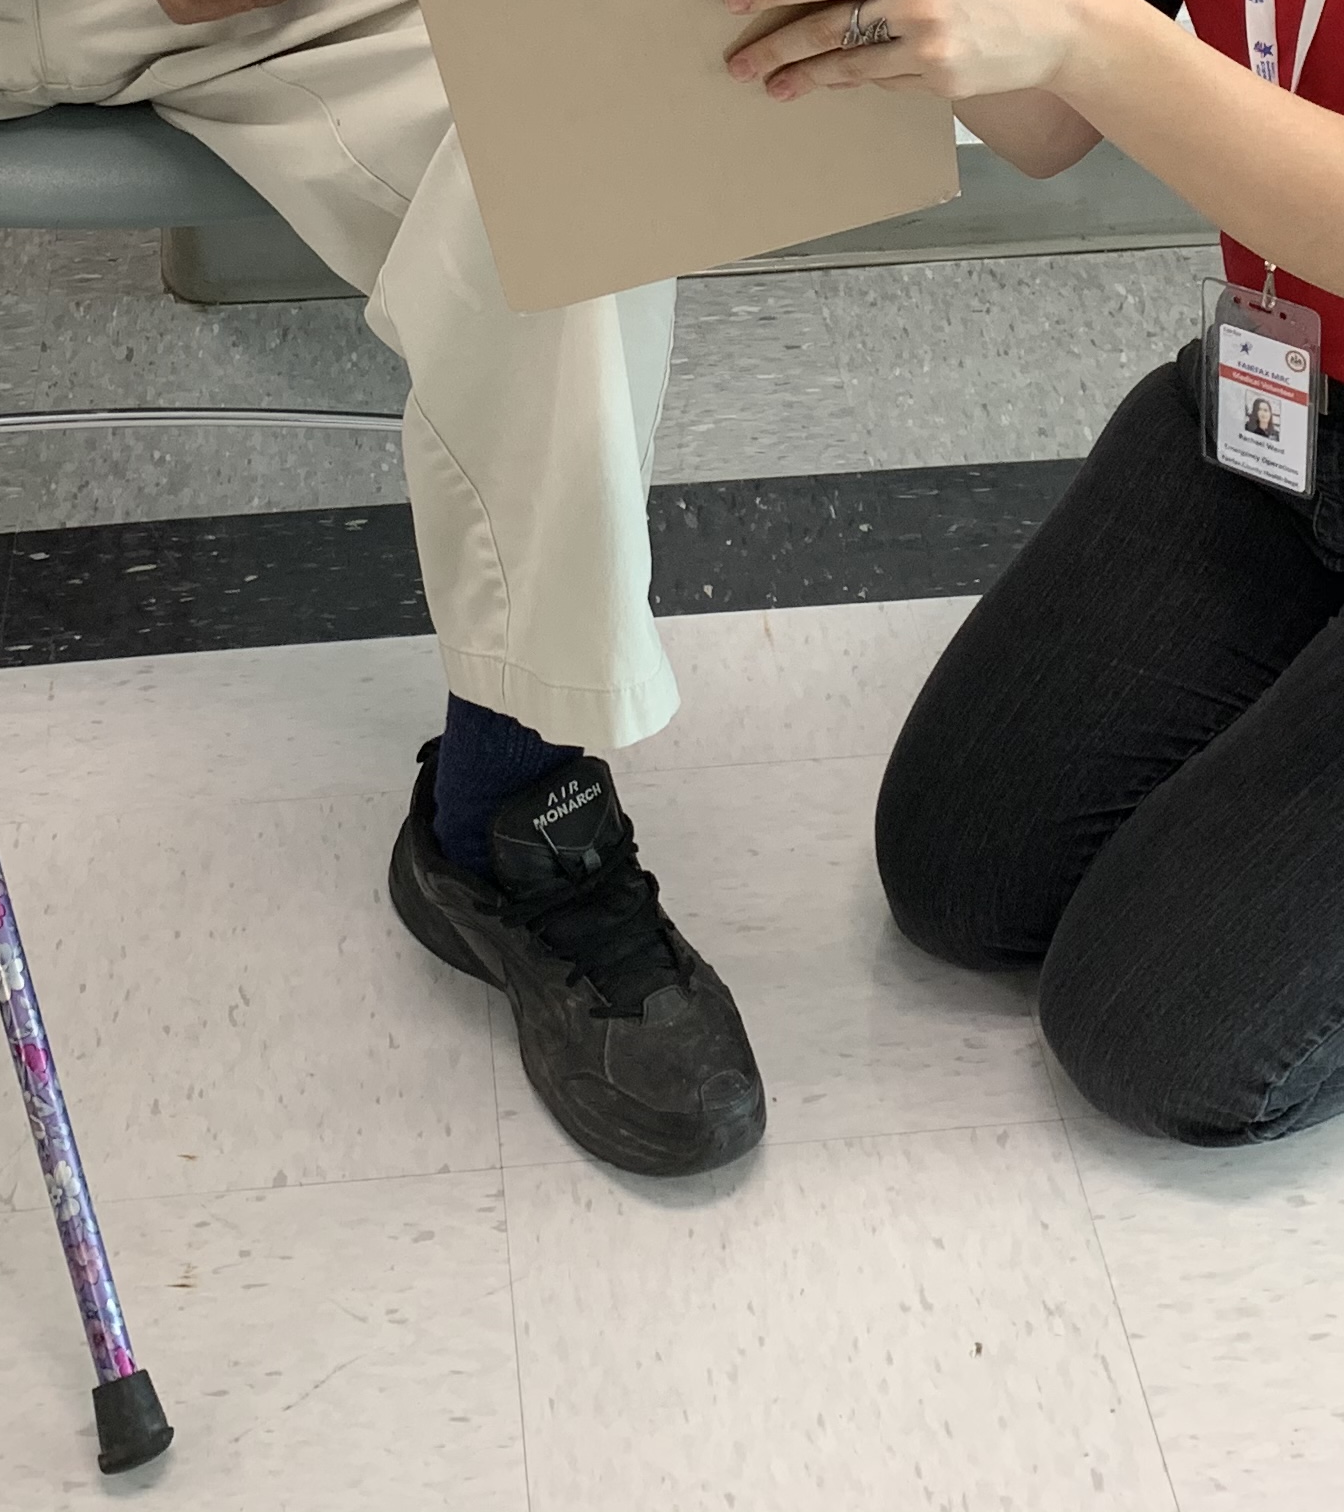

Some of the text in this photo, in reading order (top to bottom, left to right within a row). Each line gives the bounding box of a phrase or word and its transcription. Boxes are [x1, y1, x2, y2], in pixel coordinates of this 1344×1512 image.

[1237, 360, 1270, 377] FAIRFAX
[533, 782, 602, 830] MONARCH
[548, 779, 579, 807] AIR
